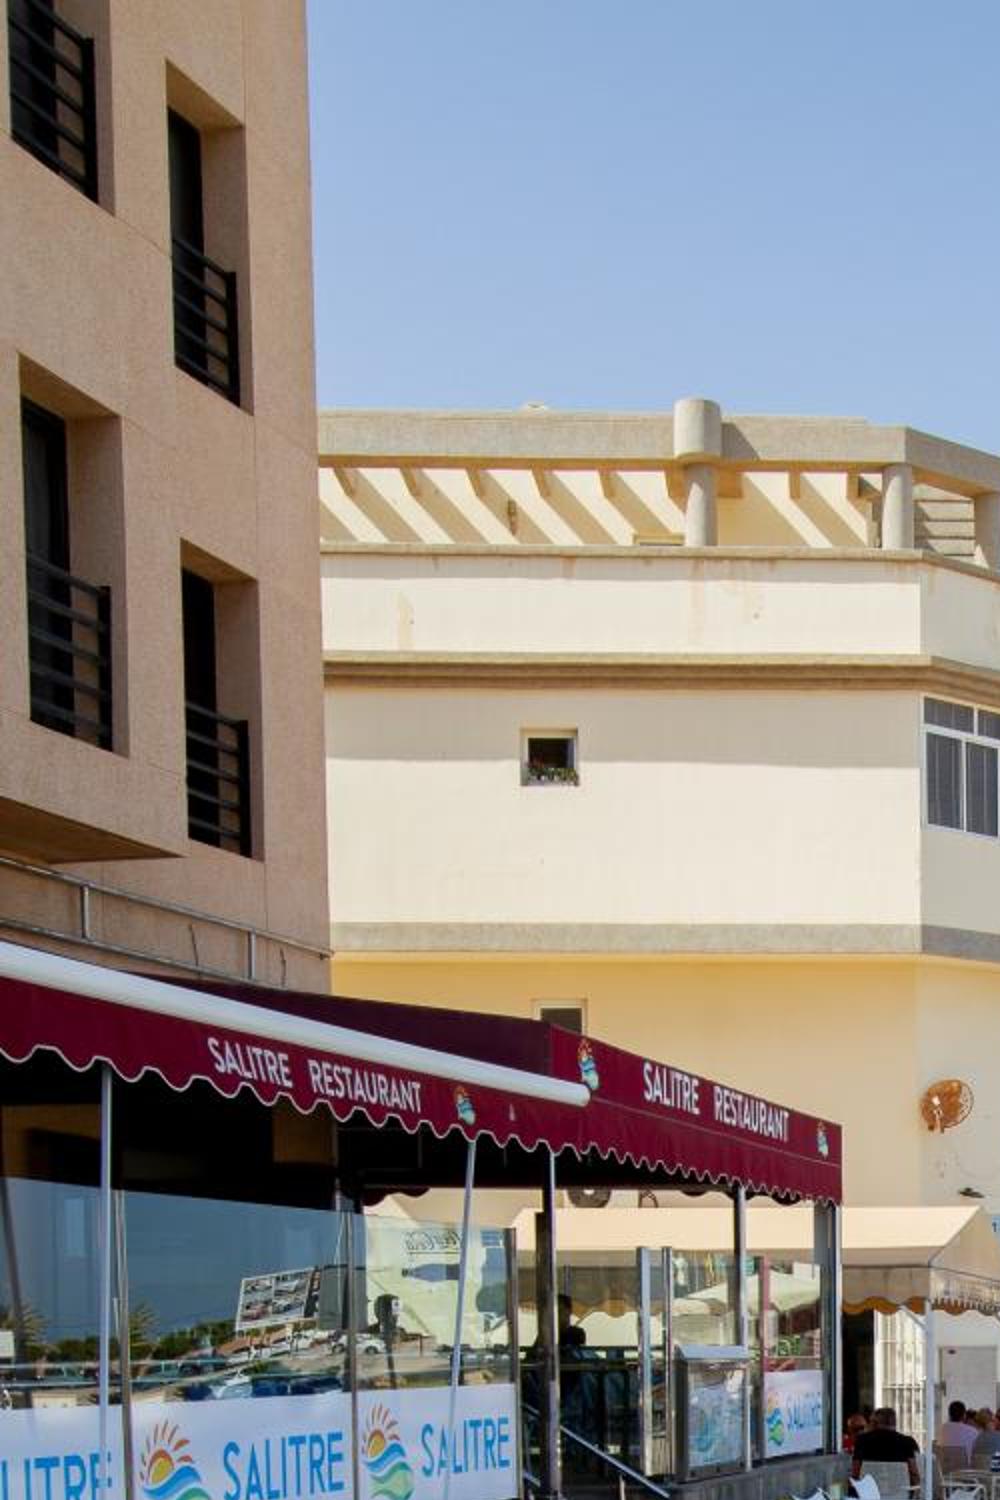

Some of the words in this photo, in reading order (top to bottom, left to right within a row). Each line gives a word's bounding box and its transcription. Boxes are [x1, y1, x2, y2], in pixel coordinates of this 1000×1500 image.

[207, 1036, 293, 1088] SALITRE
[307, 1058, 422, 1113] RESTAURANT
[643, 1061, 700, 1115] SALITRE
[713, 1085, 790, 1142] RESTAURANT
[420, 1416, 510, 1478] SALITRE
